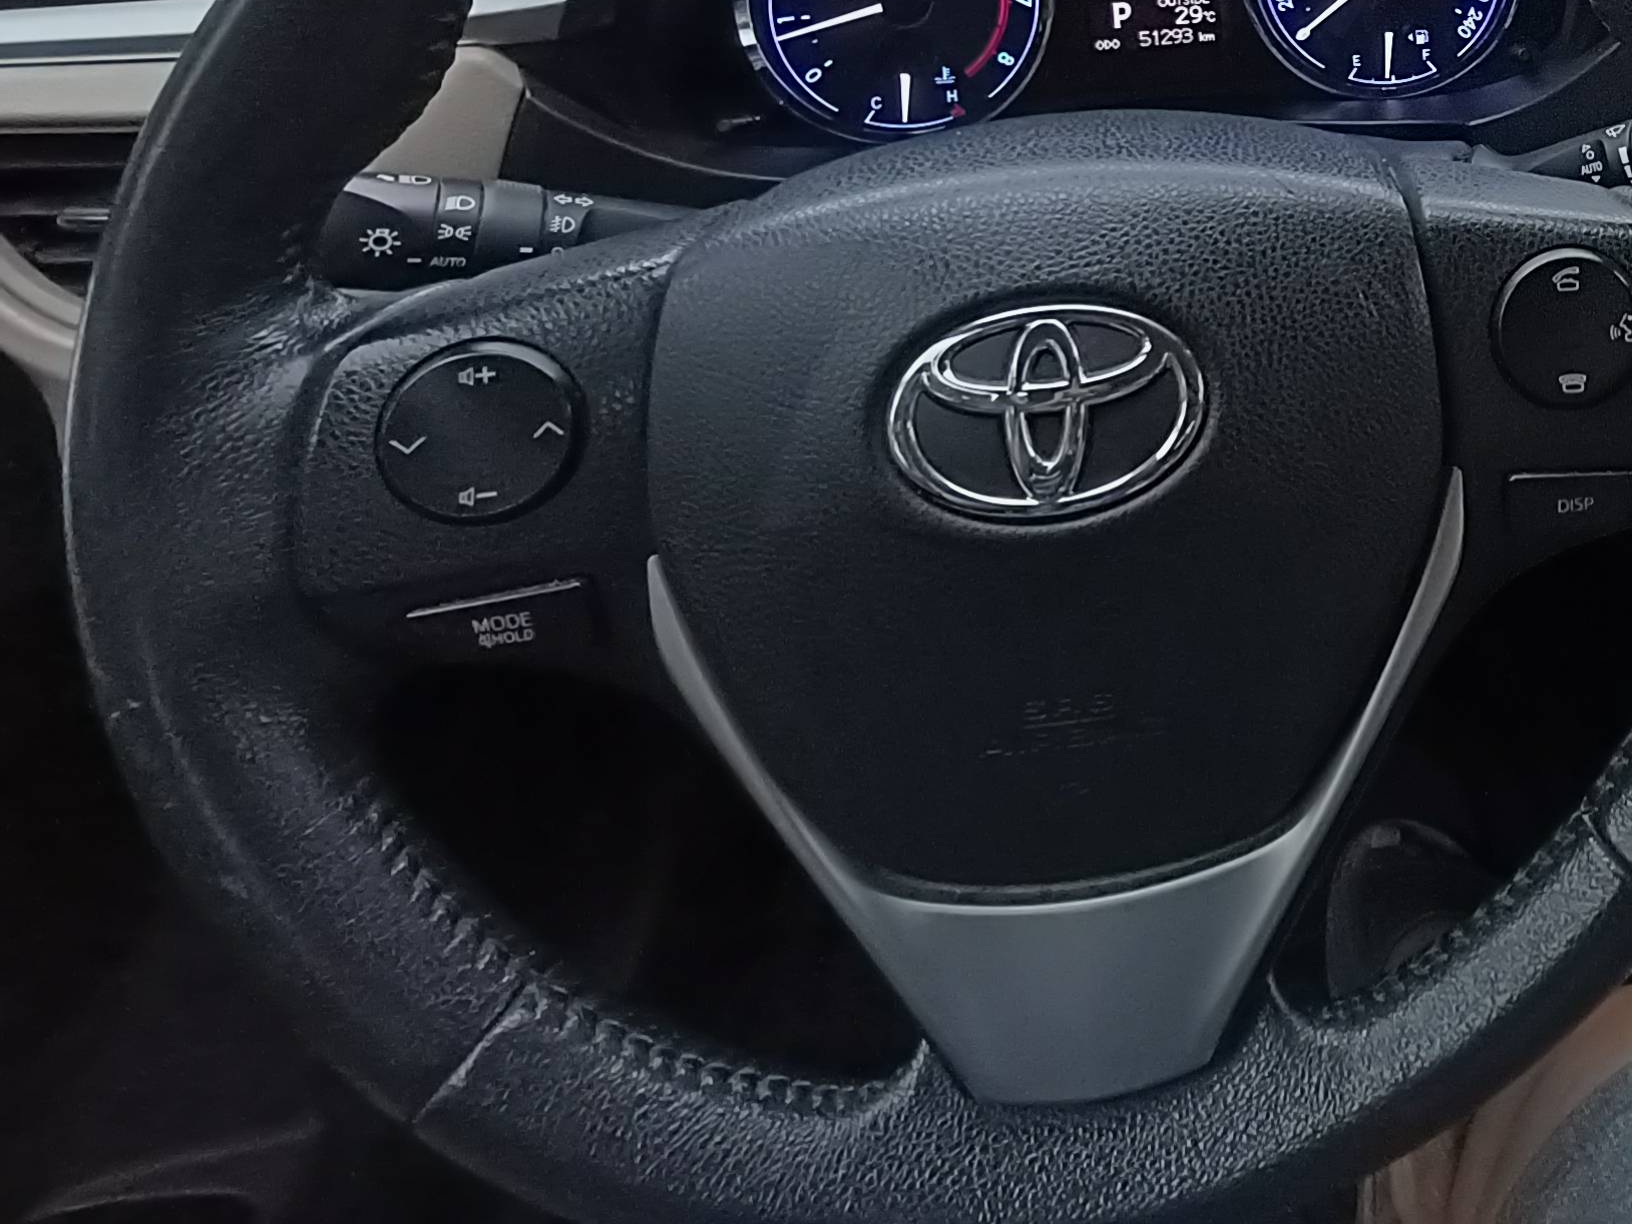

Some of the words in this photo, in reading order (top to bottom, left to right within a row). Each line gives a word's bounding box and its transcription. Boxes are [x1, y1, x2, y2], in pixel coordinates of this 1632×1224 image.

[777, 15, 796, 25] 1
[1111, 1, 1132, 29] P
[1456, 6, 1484, 40] 240
[1094, 38, 1121, 51] ODO
[1137, 27, 1194, 48] 51293
[1197, 30, 1217, 43] km
[997, 50, 1016, 67] 8
[1352, 54, 1362, 67] E
[1421, 48, 1432, 61] F
[805, 67, 823, 84] 0
[870, 96, 882, 110] C
[946, 89, 959, 103] H
[1580, 160, 1603, 177] AUTO
[429, 254, 467, 269] AUTO
[1557, 496, 1595, 514] DISP
[472, 612, 534, 635] MODE
[493, 628, 535, 647] HOLD
